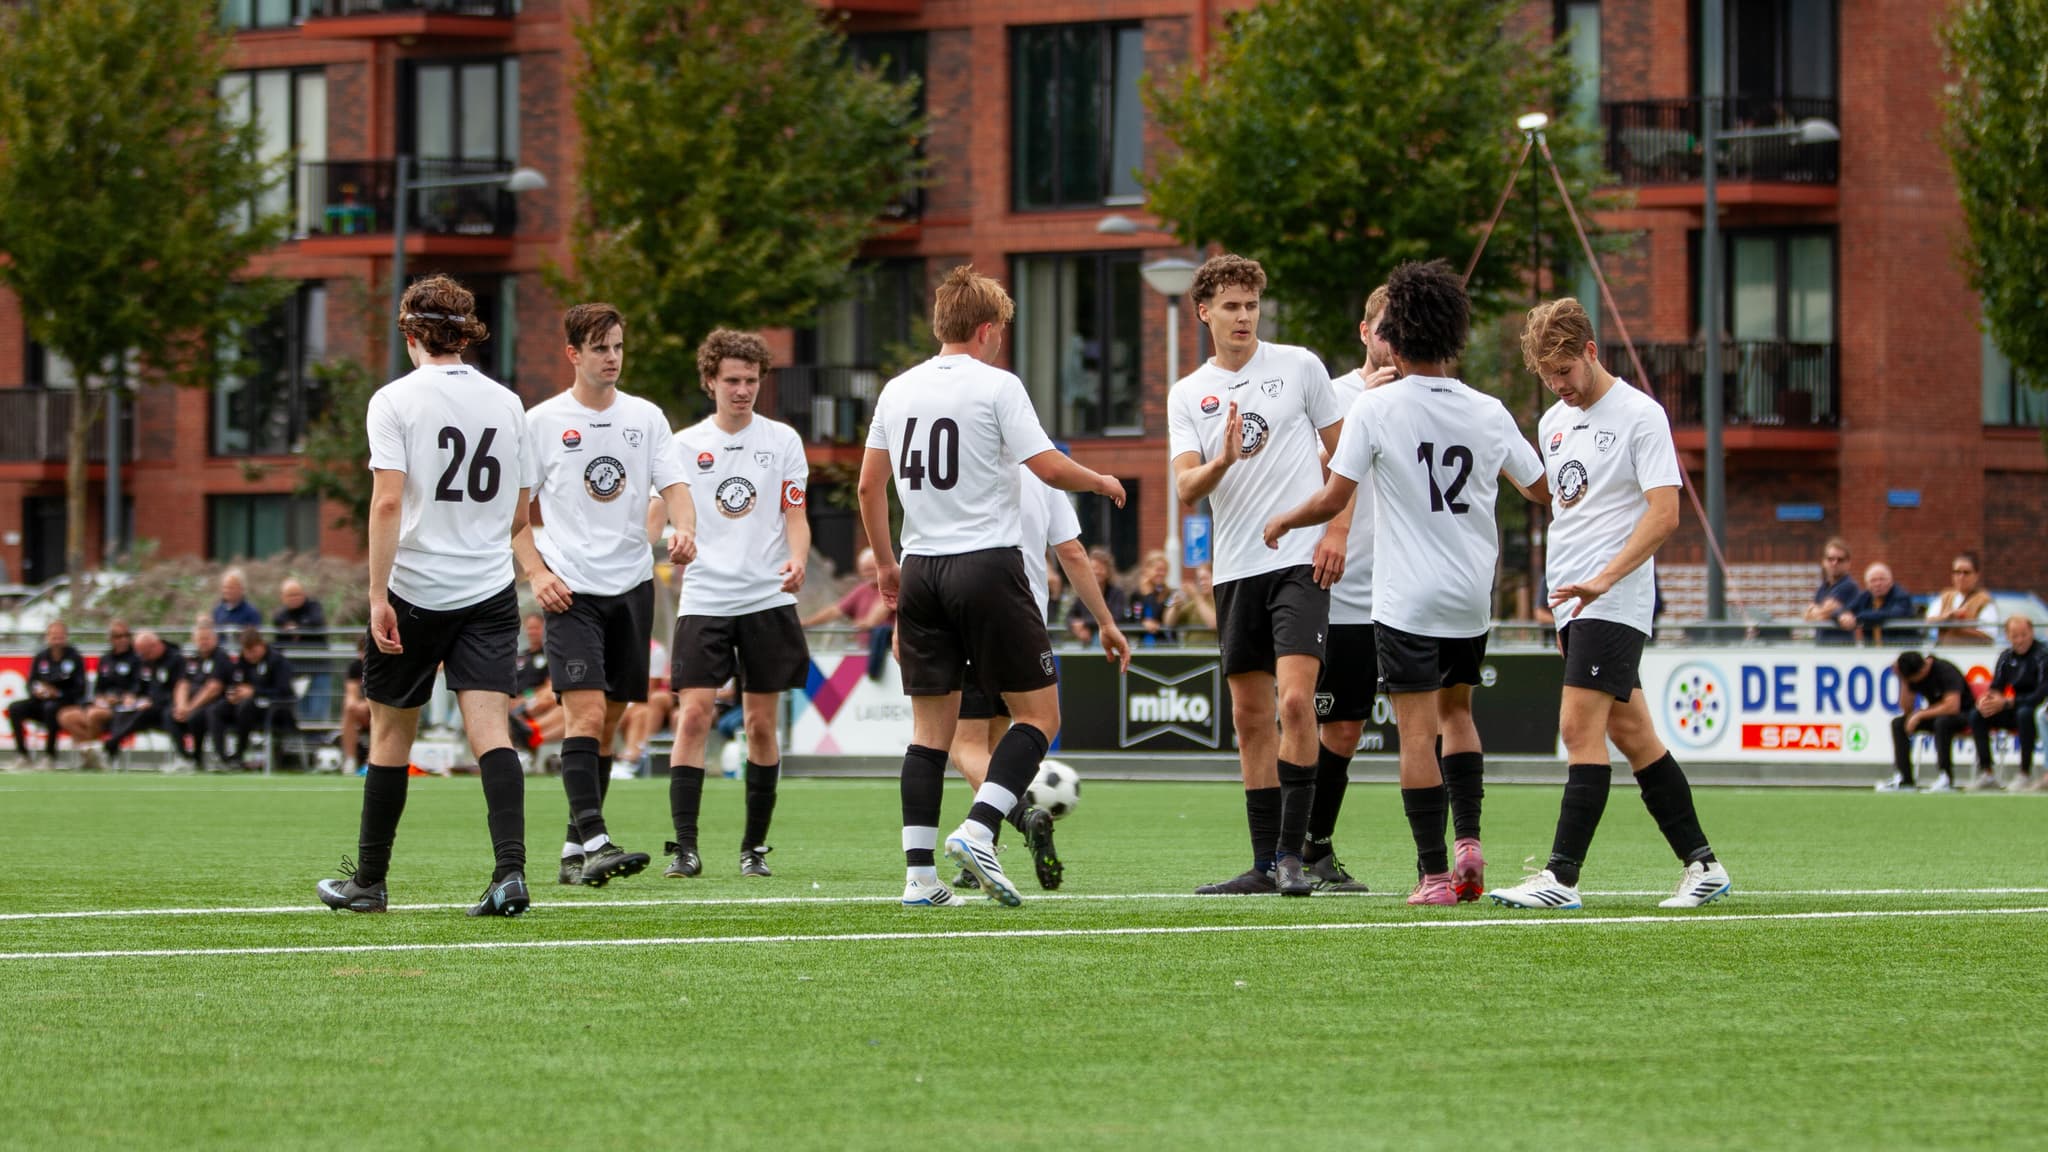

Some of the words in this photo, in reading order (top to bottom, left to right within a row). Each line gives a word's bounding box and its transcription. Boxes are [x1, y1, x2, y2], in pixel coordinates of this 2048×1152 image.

[435, 426, 501, 502] 26
[900, 417, 959, 490] 40
[1418, 442, 1474, 514] 12
[785, 483, 803, 505] C
[1130, 688, 1210, 721] miko
[1741, 665, 1798, 713] DE
[1815, 665, 1903, 714] ROO
[1760, 725, 1841, 749] SPAR
